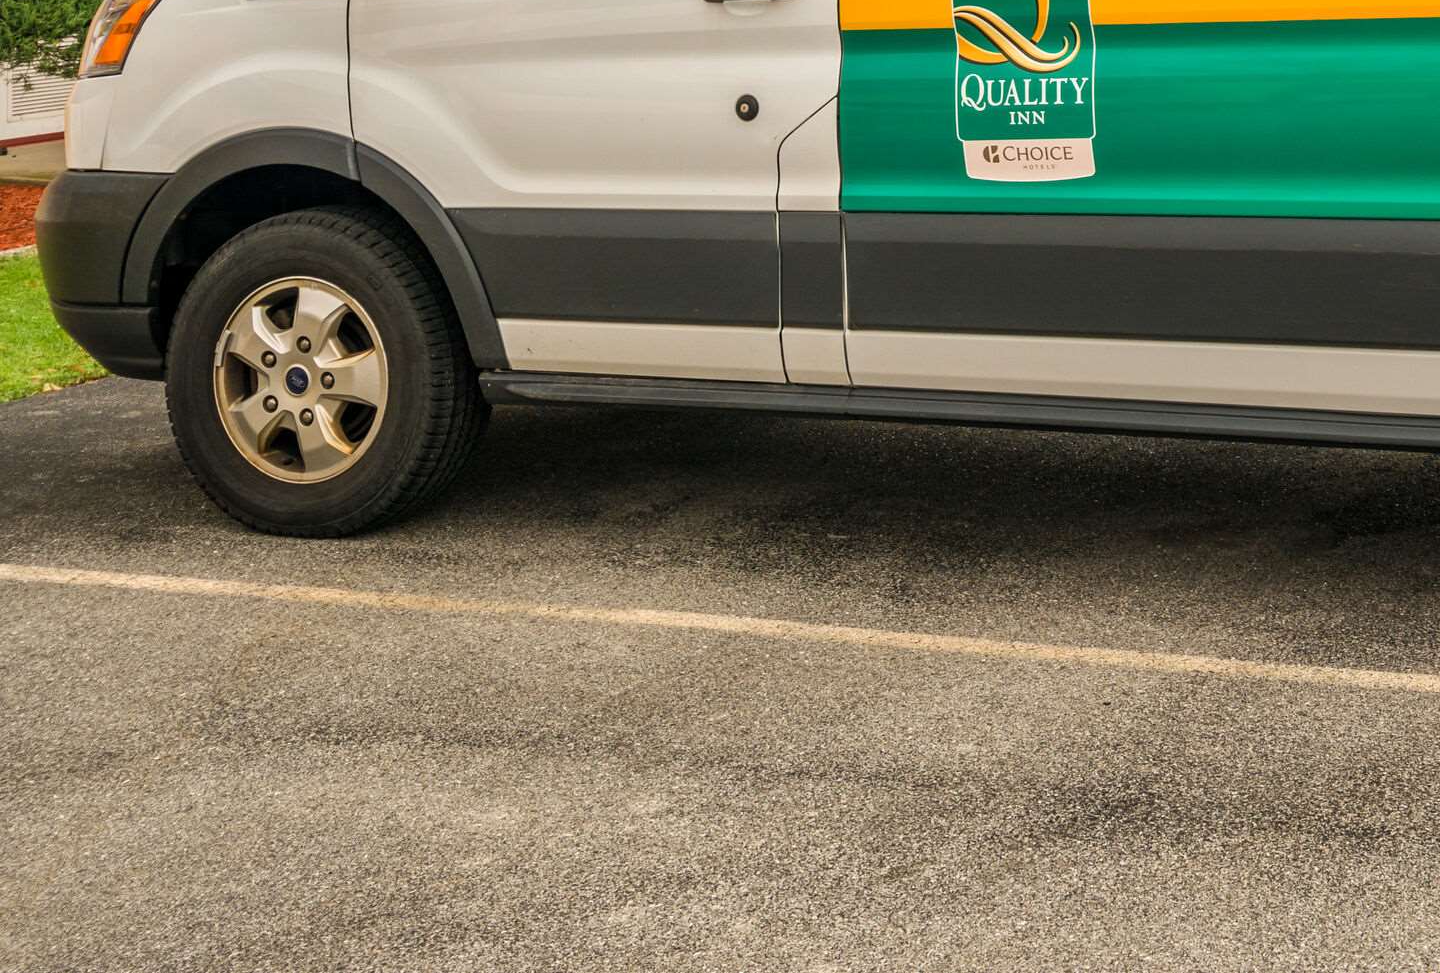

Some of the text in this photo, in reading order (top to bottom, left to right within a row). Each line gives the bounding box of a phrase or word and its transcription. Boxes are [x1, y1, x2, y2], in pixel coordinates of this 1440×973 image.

[961, 73, 1088, 111] QUALITY
[1009, 111, 1045, 125] INN
[1002, 145, 1073, 161] CHOICE
